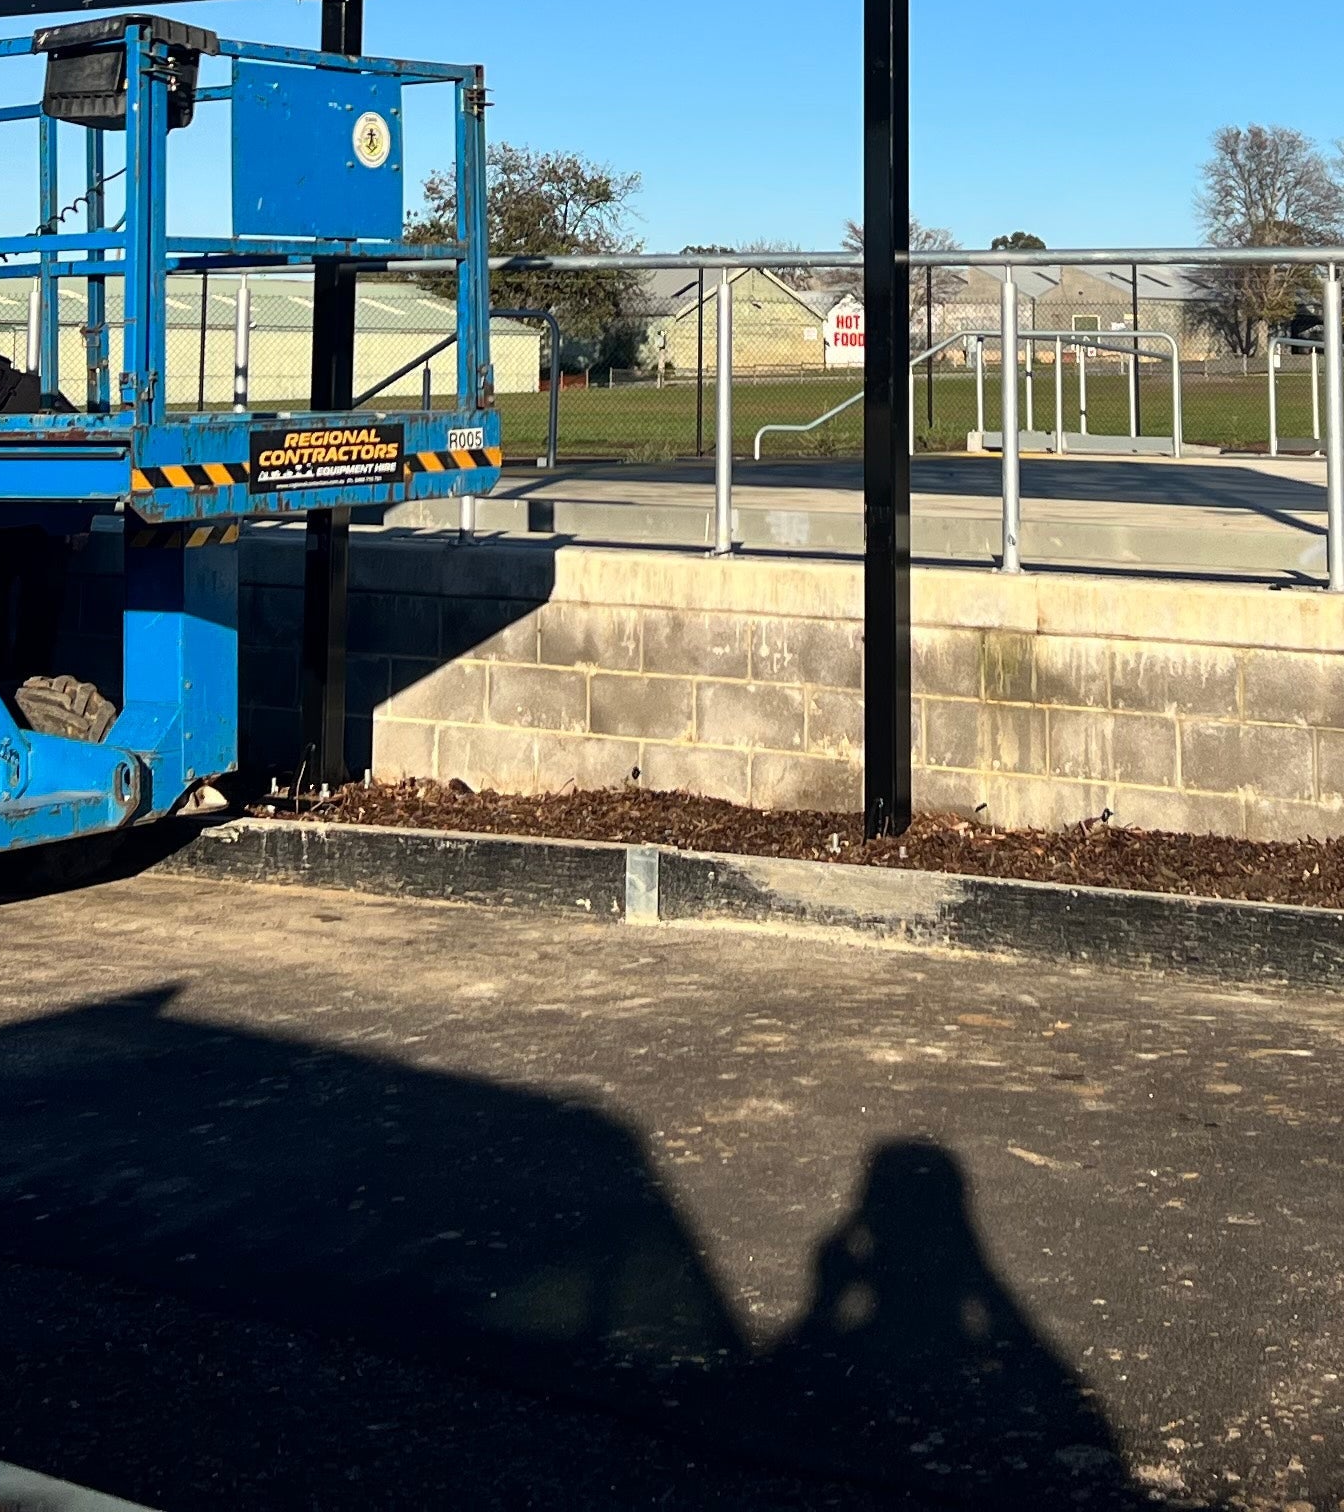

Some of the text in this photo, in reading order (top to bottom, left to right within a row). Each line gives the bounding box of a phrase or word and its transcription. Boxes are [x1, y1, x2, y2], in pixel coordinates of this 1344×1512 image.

[836, 315, 861, 330] HOT
[284, 428, 381, 449] REGIONAL
[449, 430, 483, 450] R005
[259, 442, 400, 467] CONTRACTORS
[316, 461, 398, 477] EQUIPMENT HIRE
